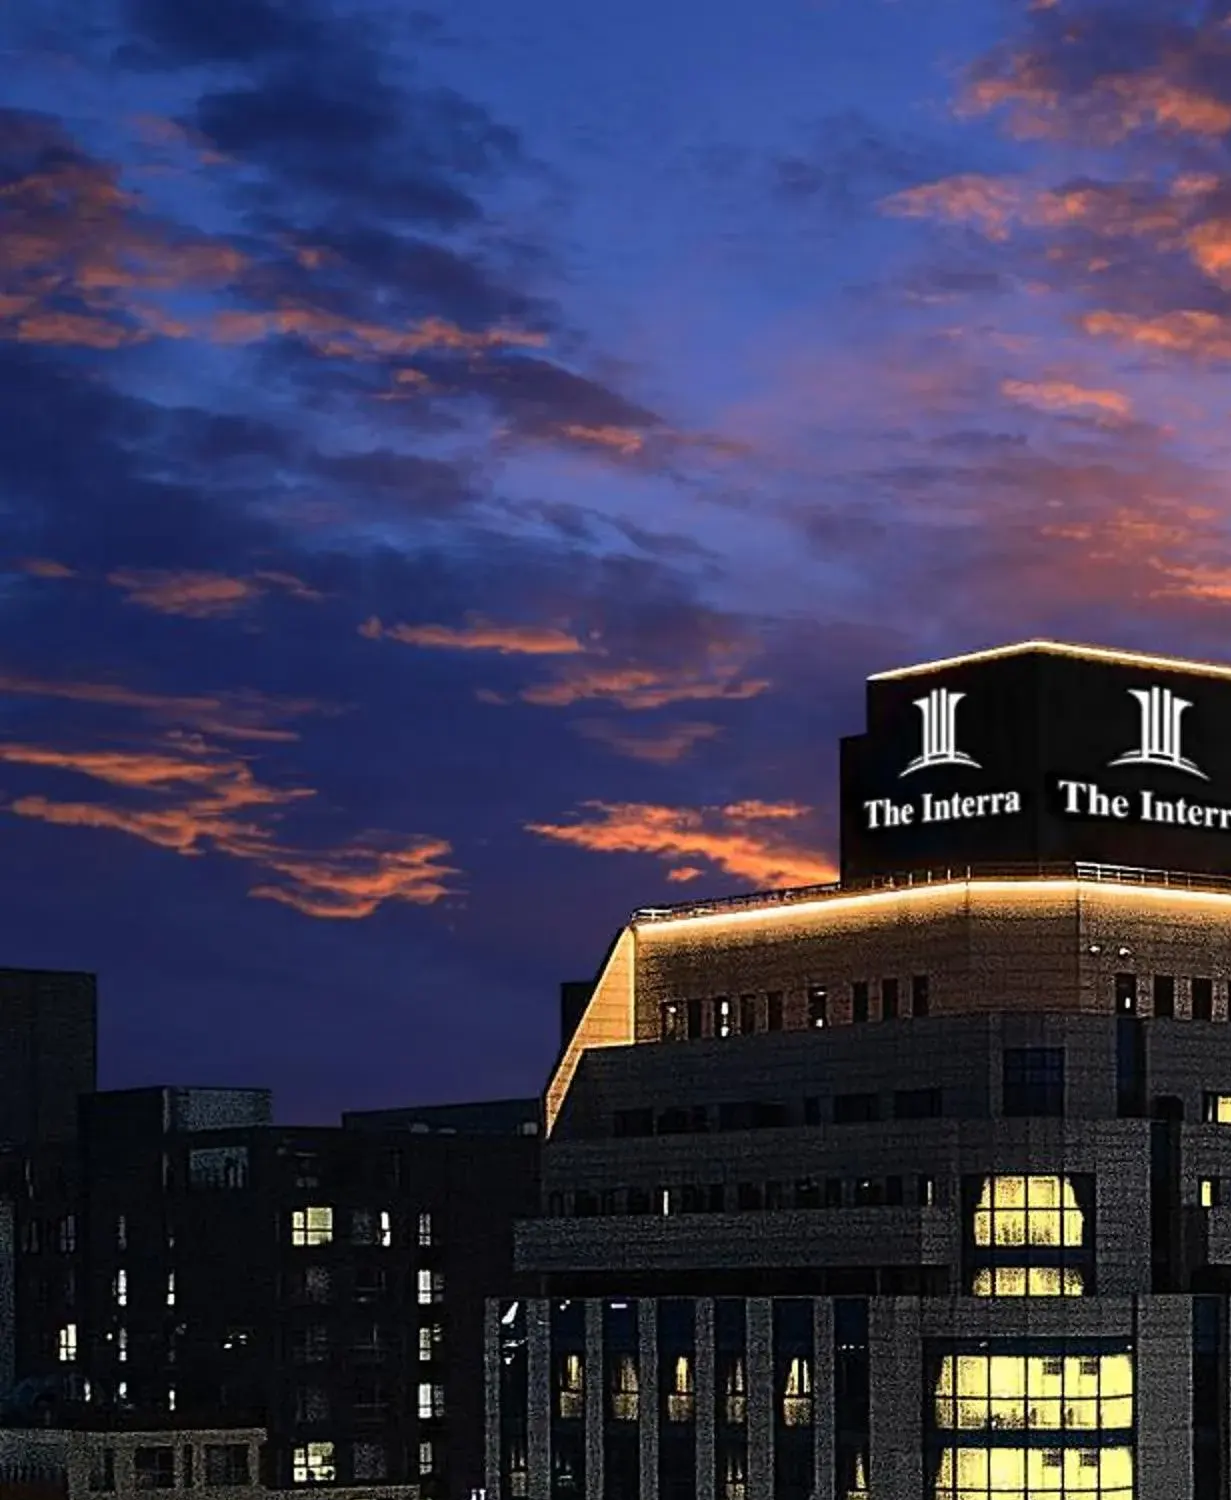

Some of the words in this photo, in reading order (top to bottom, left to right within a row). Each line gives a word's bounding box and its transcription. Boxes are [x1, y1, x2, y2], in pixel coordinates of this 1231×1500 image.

[864, 798, 915, 829] The
[921, 789, 1021, 823] Interra
[1058, 778, 1130, 819] The
